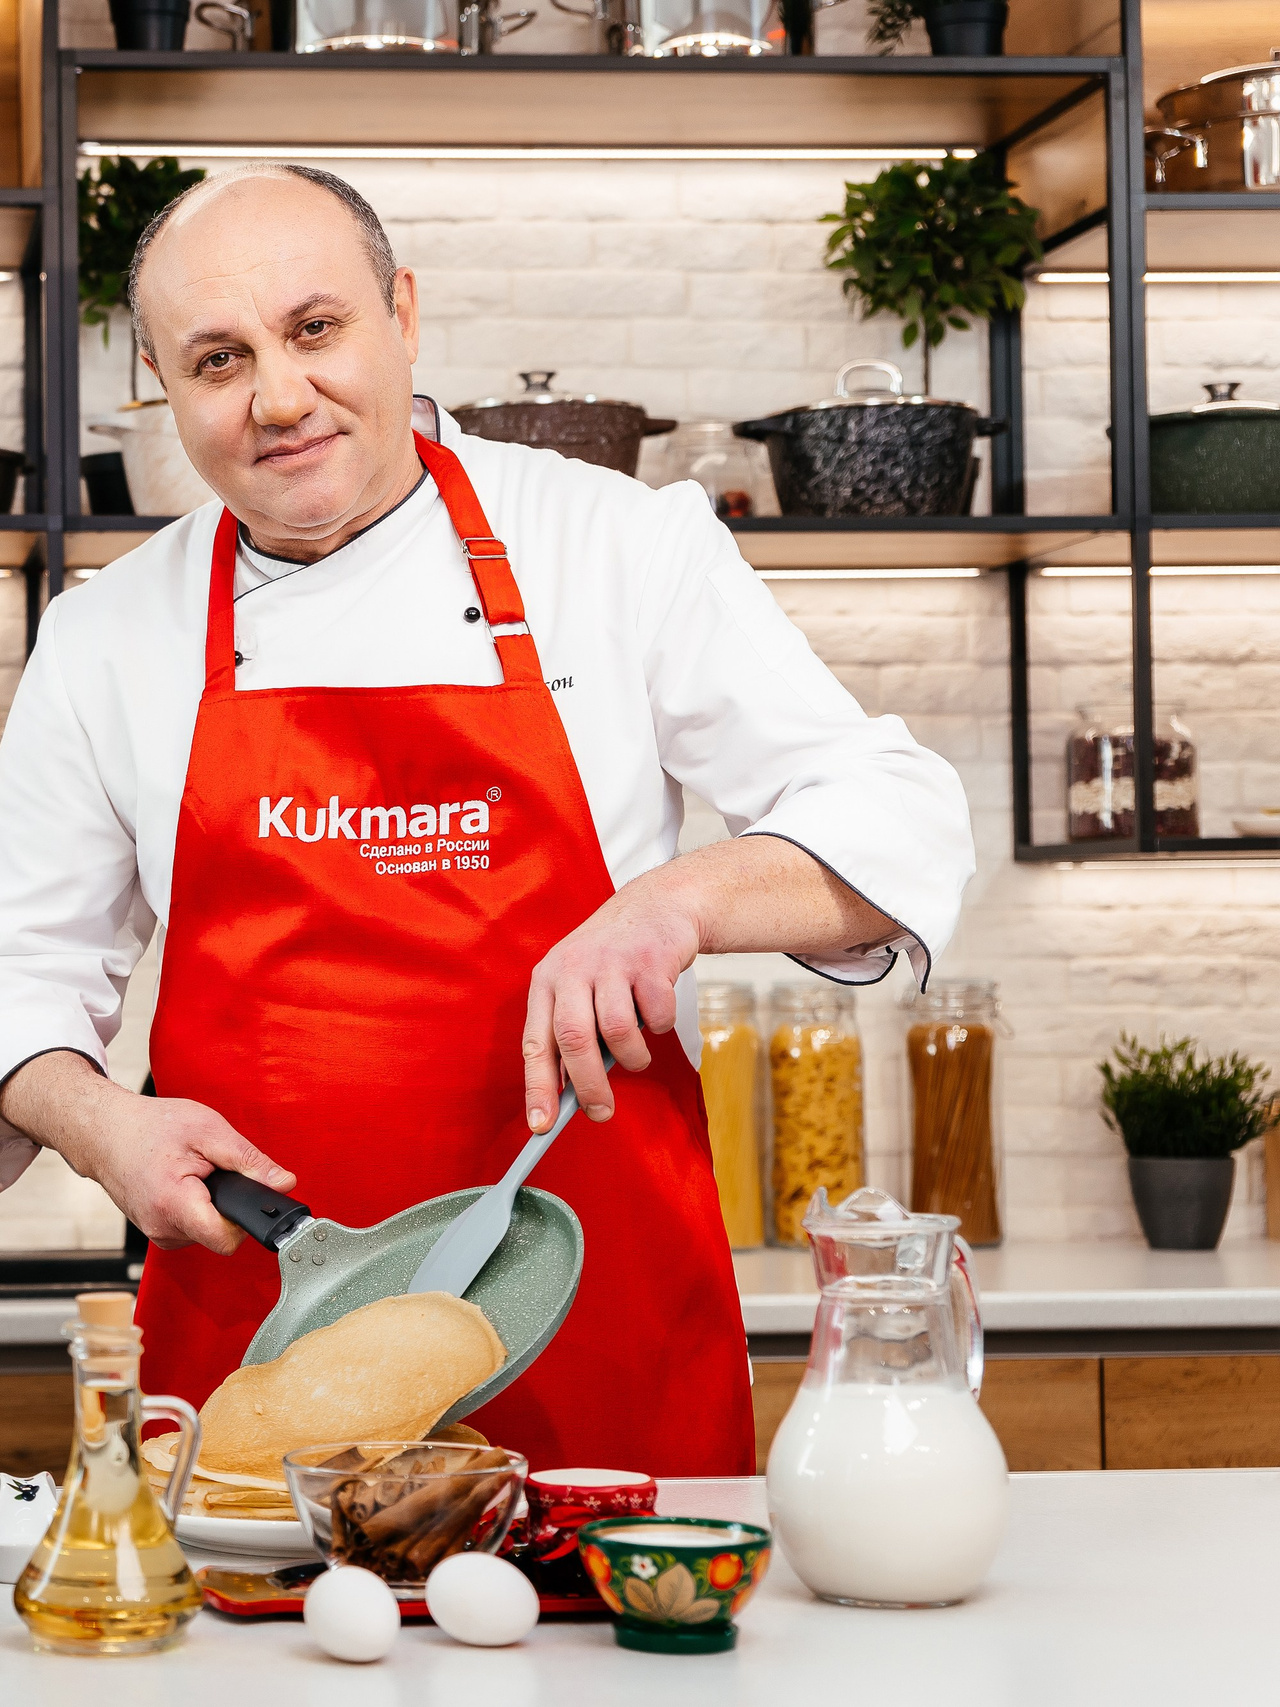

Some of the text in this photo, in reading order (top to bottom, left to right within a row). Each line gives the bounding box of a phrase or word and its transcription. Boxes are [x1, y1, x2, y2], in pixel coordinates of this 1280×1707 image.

[257, 795, 490, 843] Kukmara
[359, 838, 490, 859] Сделано в России
[375, 854, 490, 876] Основан в 1950
